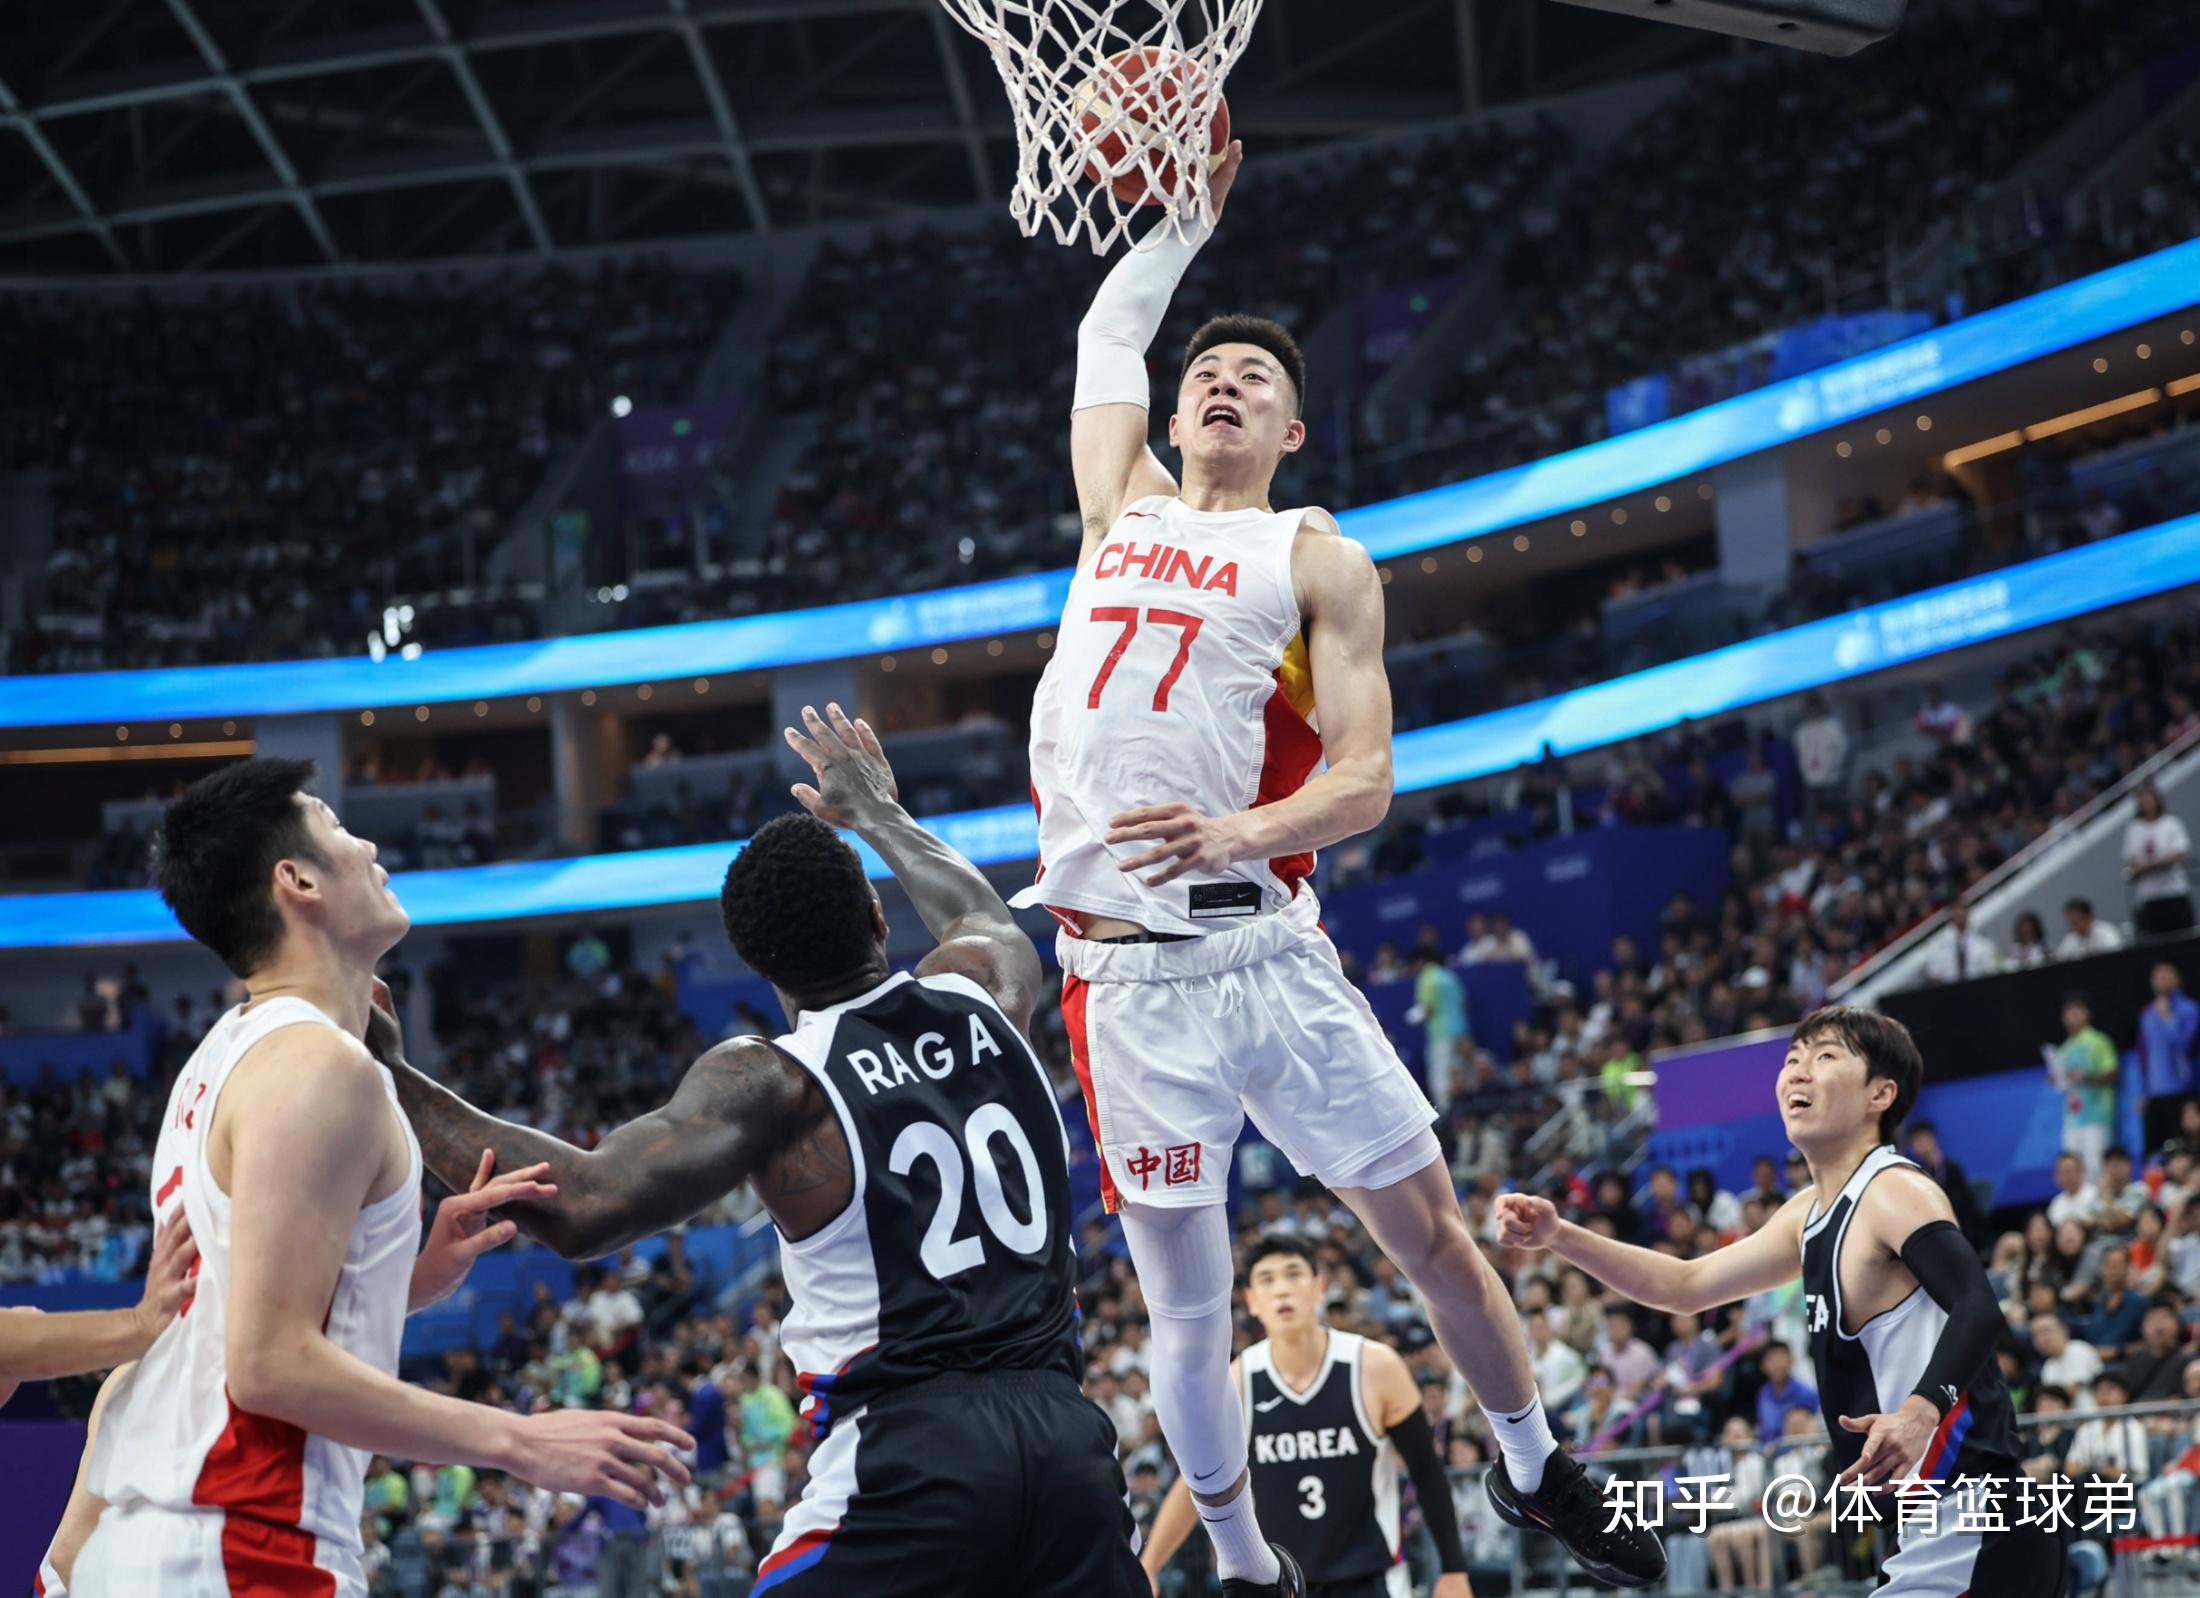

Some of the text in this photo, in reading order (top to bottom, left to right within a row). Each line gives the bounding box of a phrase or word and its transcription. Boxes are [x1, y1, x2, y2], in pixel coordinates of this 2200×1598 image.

[1095, 542, 1238, 597] CHINA
[1087, 606, 1204, 712] 77
[888, 1101, 1048, 1279] 20
[1127, 1142, 1201, 1191] 中国
[1255, 1427, 1358, 1463] KOREA
[1298, 1476, 1326, 1520] 3
